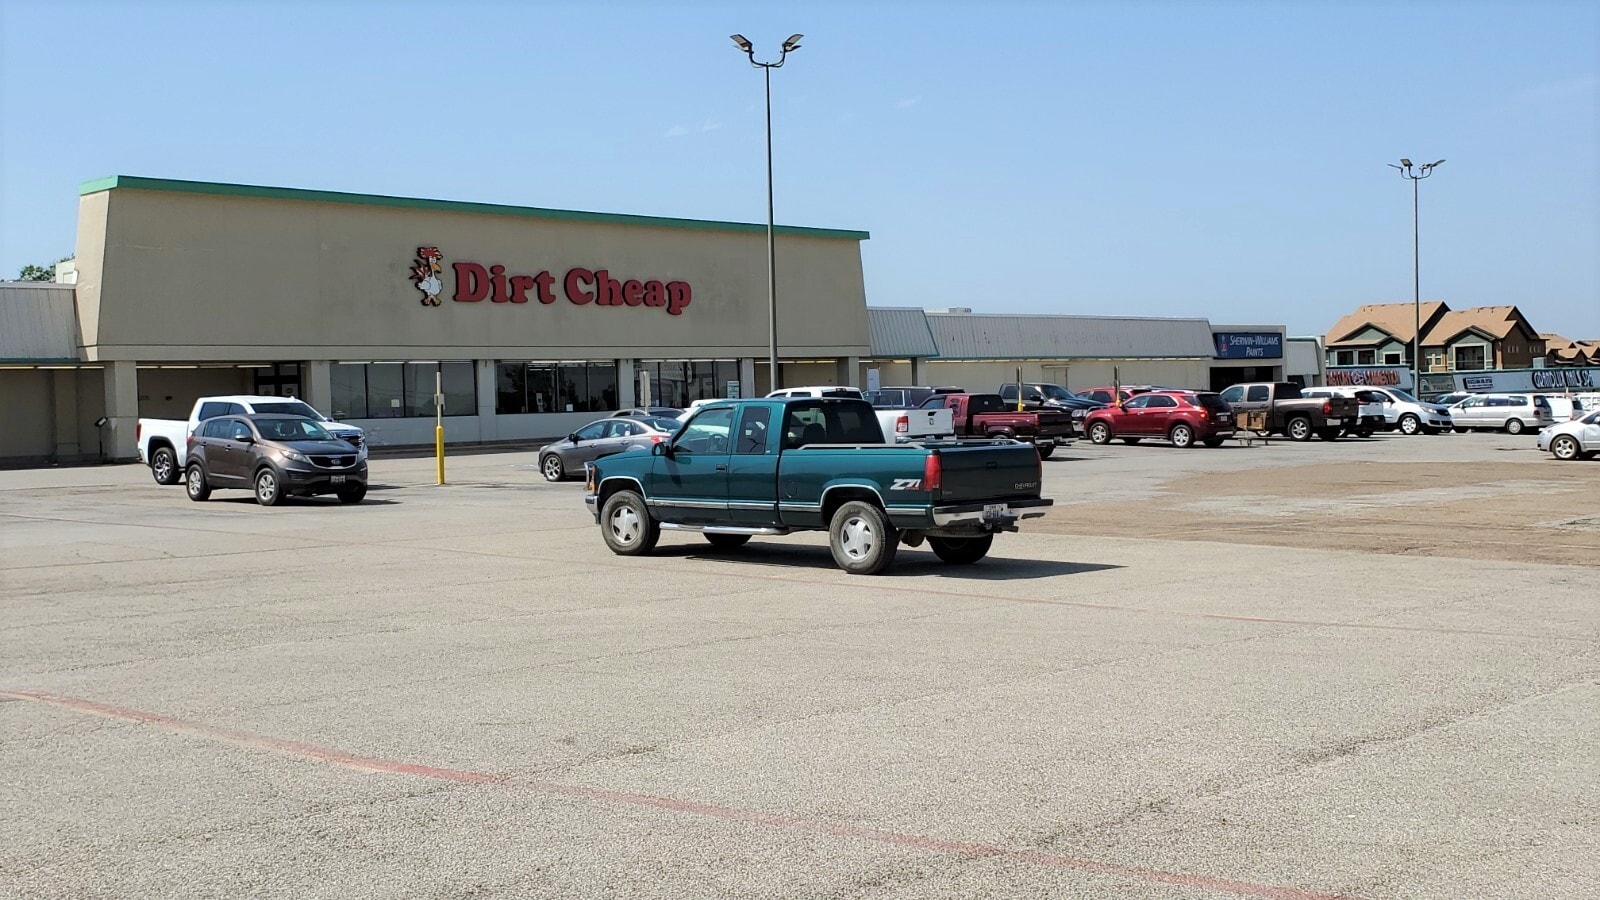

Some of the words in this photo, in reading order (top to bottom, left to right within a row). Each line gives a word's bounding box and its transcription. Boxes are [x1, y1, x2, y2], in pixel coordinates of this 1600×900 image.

[452, 262, 556, 304] Dirt
[564, 267, 692, 315] Cheap
[890, 478, 922, 490] Z71
